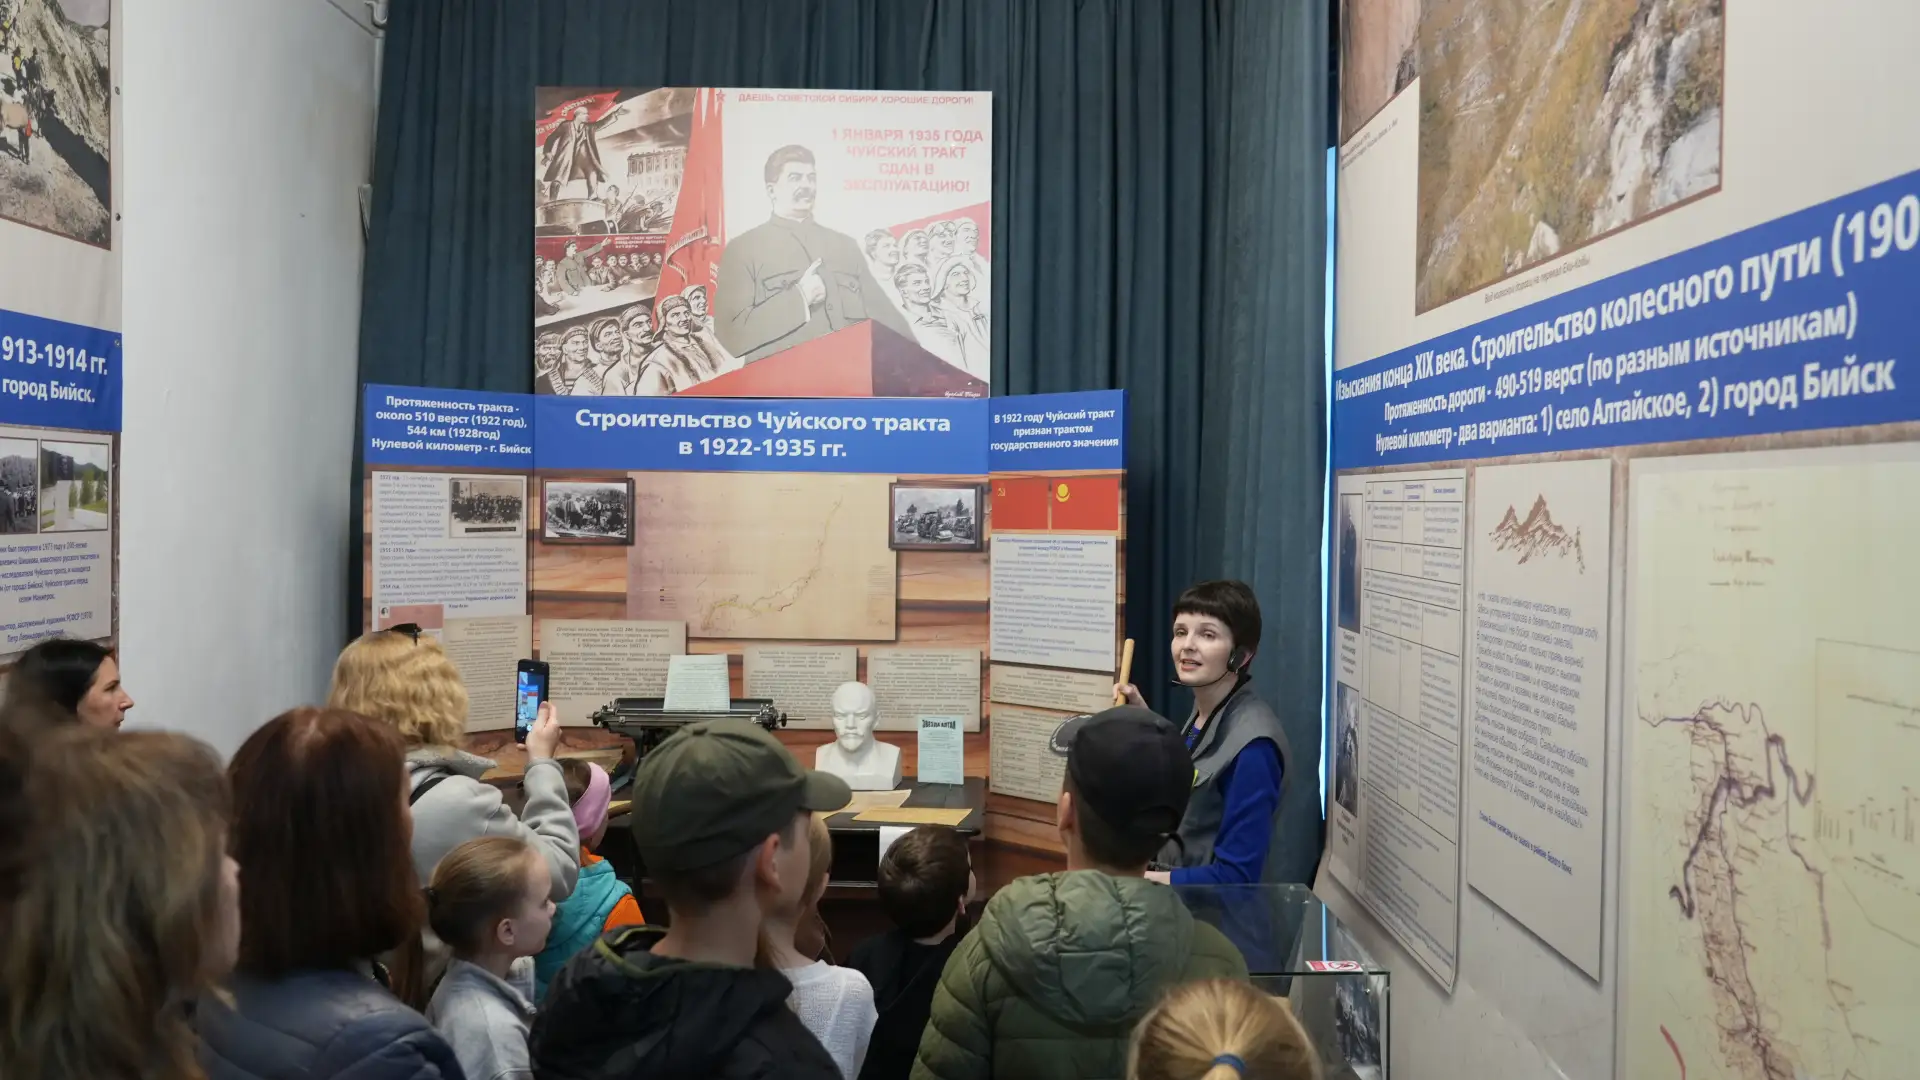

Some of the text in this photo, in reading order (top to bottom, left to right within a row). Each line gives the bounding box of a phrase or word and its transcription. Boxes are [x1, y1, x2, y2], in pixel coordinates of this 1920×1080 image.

[738, 92, 974, 105] ДАЕШЬ СОВЕТСКОЙ СИБИРИ ХОРОШИЕ ДОРОГИ!
[832, 129, 983, 143] 1 ЯНВАРЯ 1935 ГОДА
[846, 145, 967, 159] ЧУЙСКИЙ ТРАКТ
[878, 163, 934, 176] СДАН В
[843, 179, 970, 193] ЭКСПЛУАТАЦИЮ!
[1382, 363, 1414, 389] конца
[1435, 346, 1469, 372] века.
[1471, 307, 1596, 370] Строительство
[1600, 265, 1734, 331] колесного
[1740, 237, 1822, 302] пути
[1384, 394, 1447, 422] Протяженность
[1448, 384, 1486, 413] дороги
[1495, 367, 1542, 400] 490-519
[1544, 364, 1584, 394] верст
[1587, 352, 1613, 387] (по
[1615, 339, 1690, 384] разным
[1695, 291, 1857, 361] источникам)
[90, 356, 108, 375] гг.
[2, 378, 96, 403] город Бийск.
[386, 395, 476, 411] Протяженность
[478, 403, 514, 413] тракта
[1376, 428, 1408, 456] Нулевой
[1408, 423, 1452, 448] километр
[1458, 424, 1477, 445] два
[1479, 417, 1538, 444] варианта:
[1541, 403, 1553, 435] 1)
[1555, 408, 1590, 431] село
[1592, 390, 1692, 428] Алтайское,
[1698, 377, 1718, 417] 2)
[1723, 374, 1798, 417] город
[1802, 354, 1896, 401] Бийск
[375, 411, 528, 429] около 510 верст (1922 год),
[575, 409, 951, 436] Строительство Чуйского тракта
[994, 409, 1116, 424] В 1922 году Чуйский тракт
[407, 425, 501, 441] 544 км (1928год)
[1013, 425, 1093, 438] признан трактом
[371, 438, 424, 450] Нулевой
[425, 441, 482, 454] километр
[489, 445, 497, 453] г.
[499, 443, 532, 455] Бийск
[678, 437, 848, 457] в 1922-1935 гг.
[990, 438, 1119, 452] государственного значения
